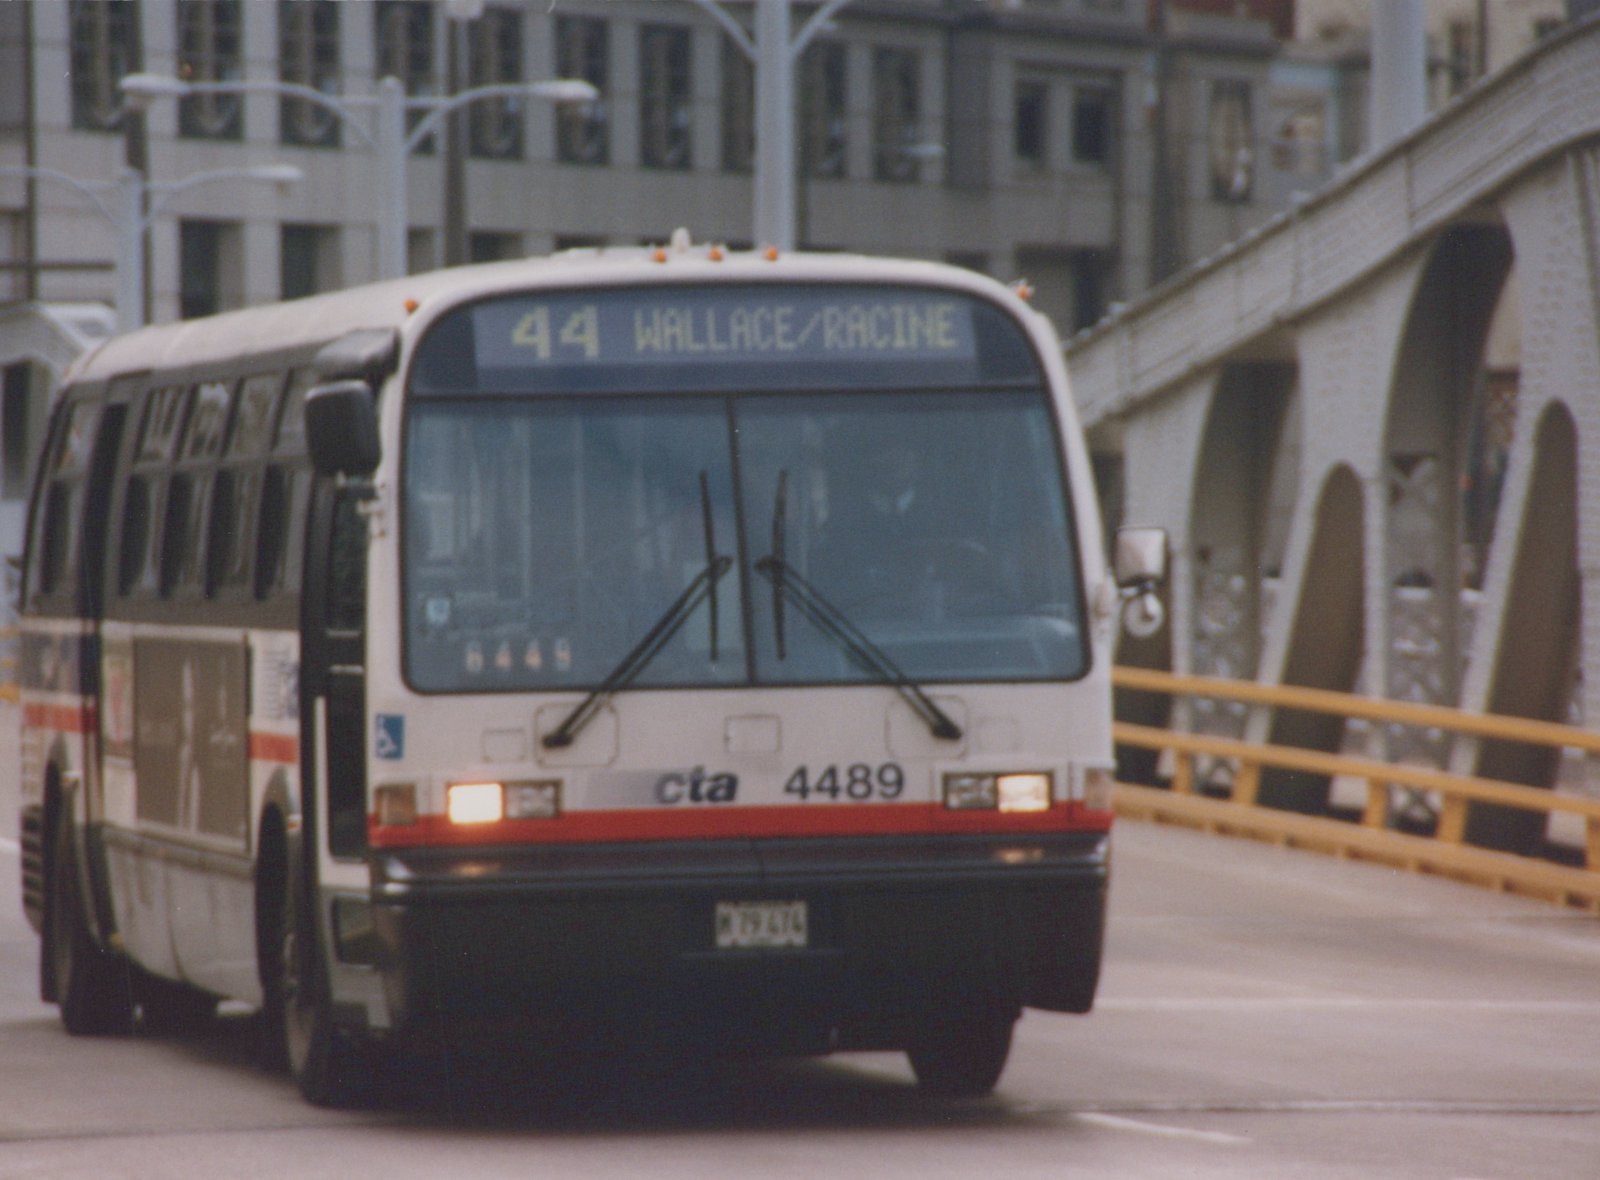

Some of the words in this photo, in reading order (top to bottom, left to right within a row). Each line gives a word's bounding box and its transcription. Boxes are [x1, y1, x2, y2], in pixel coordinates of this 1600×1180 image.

[511, 305, 599, 360] 44
[633, 302, 958, 353] WALLACE/RACINE
[655, 764, 739, 804] cta
[784, 762, 905, 800] 4489
